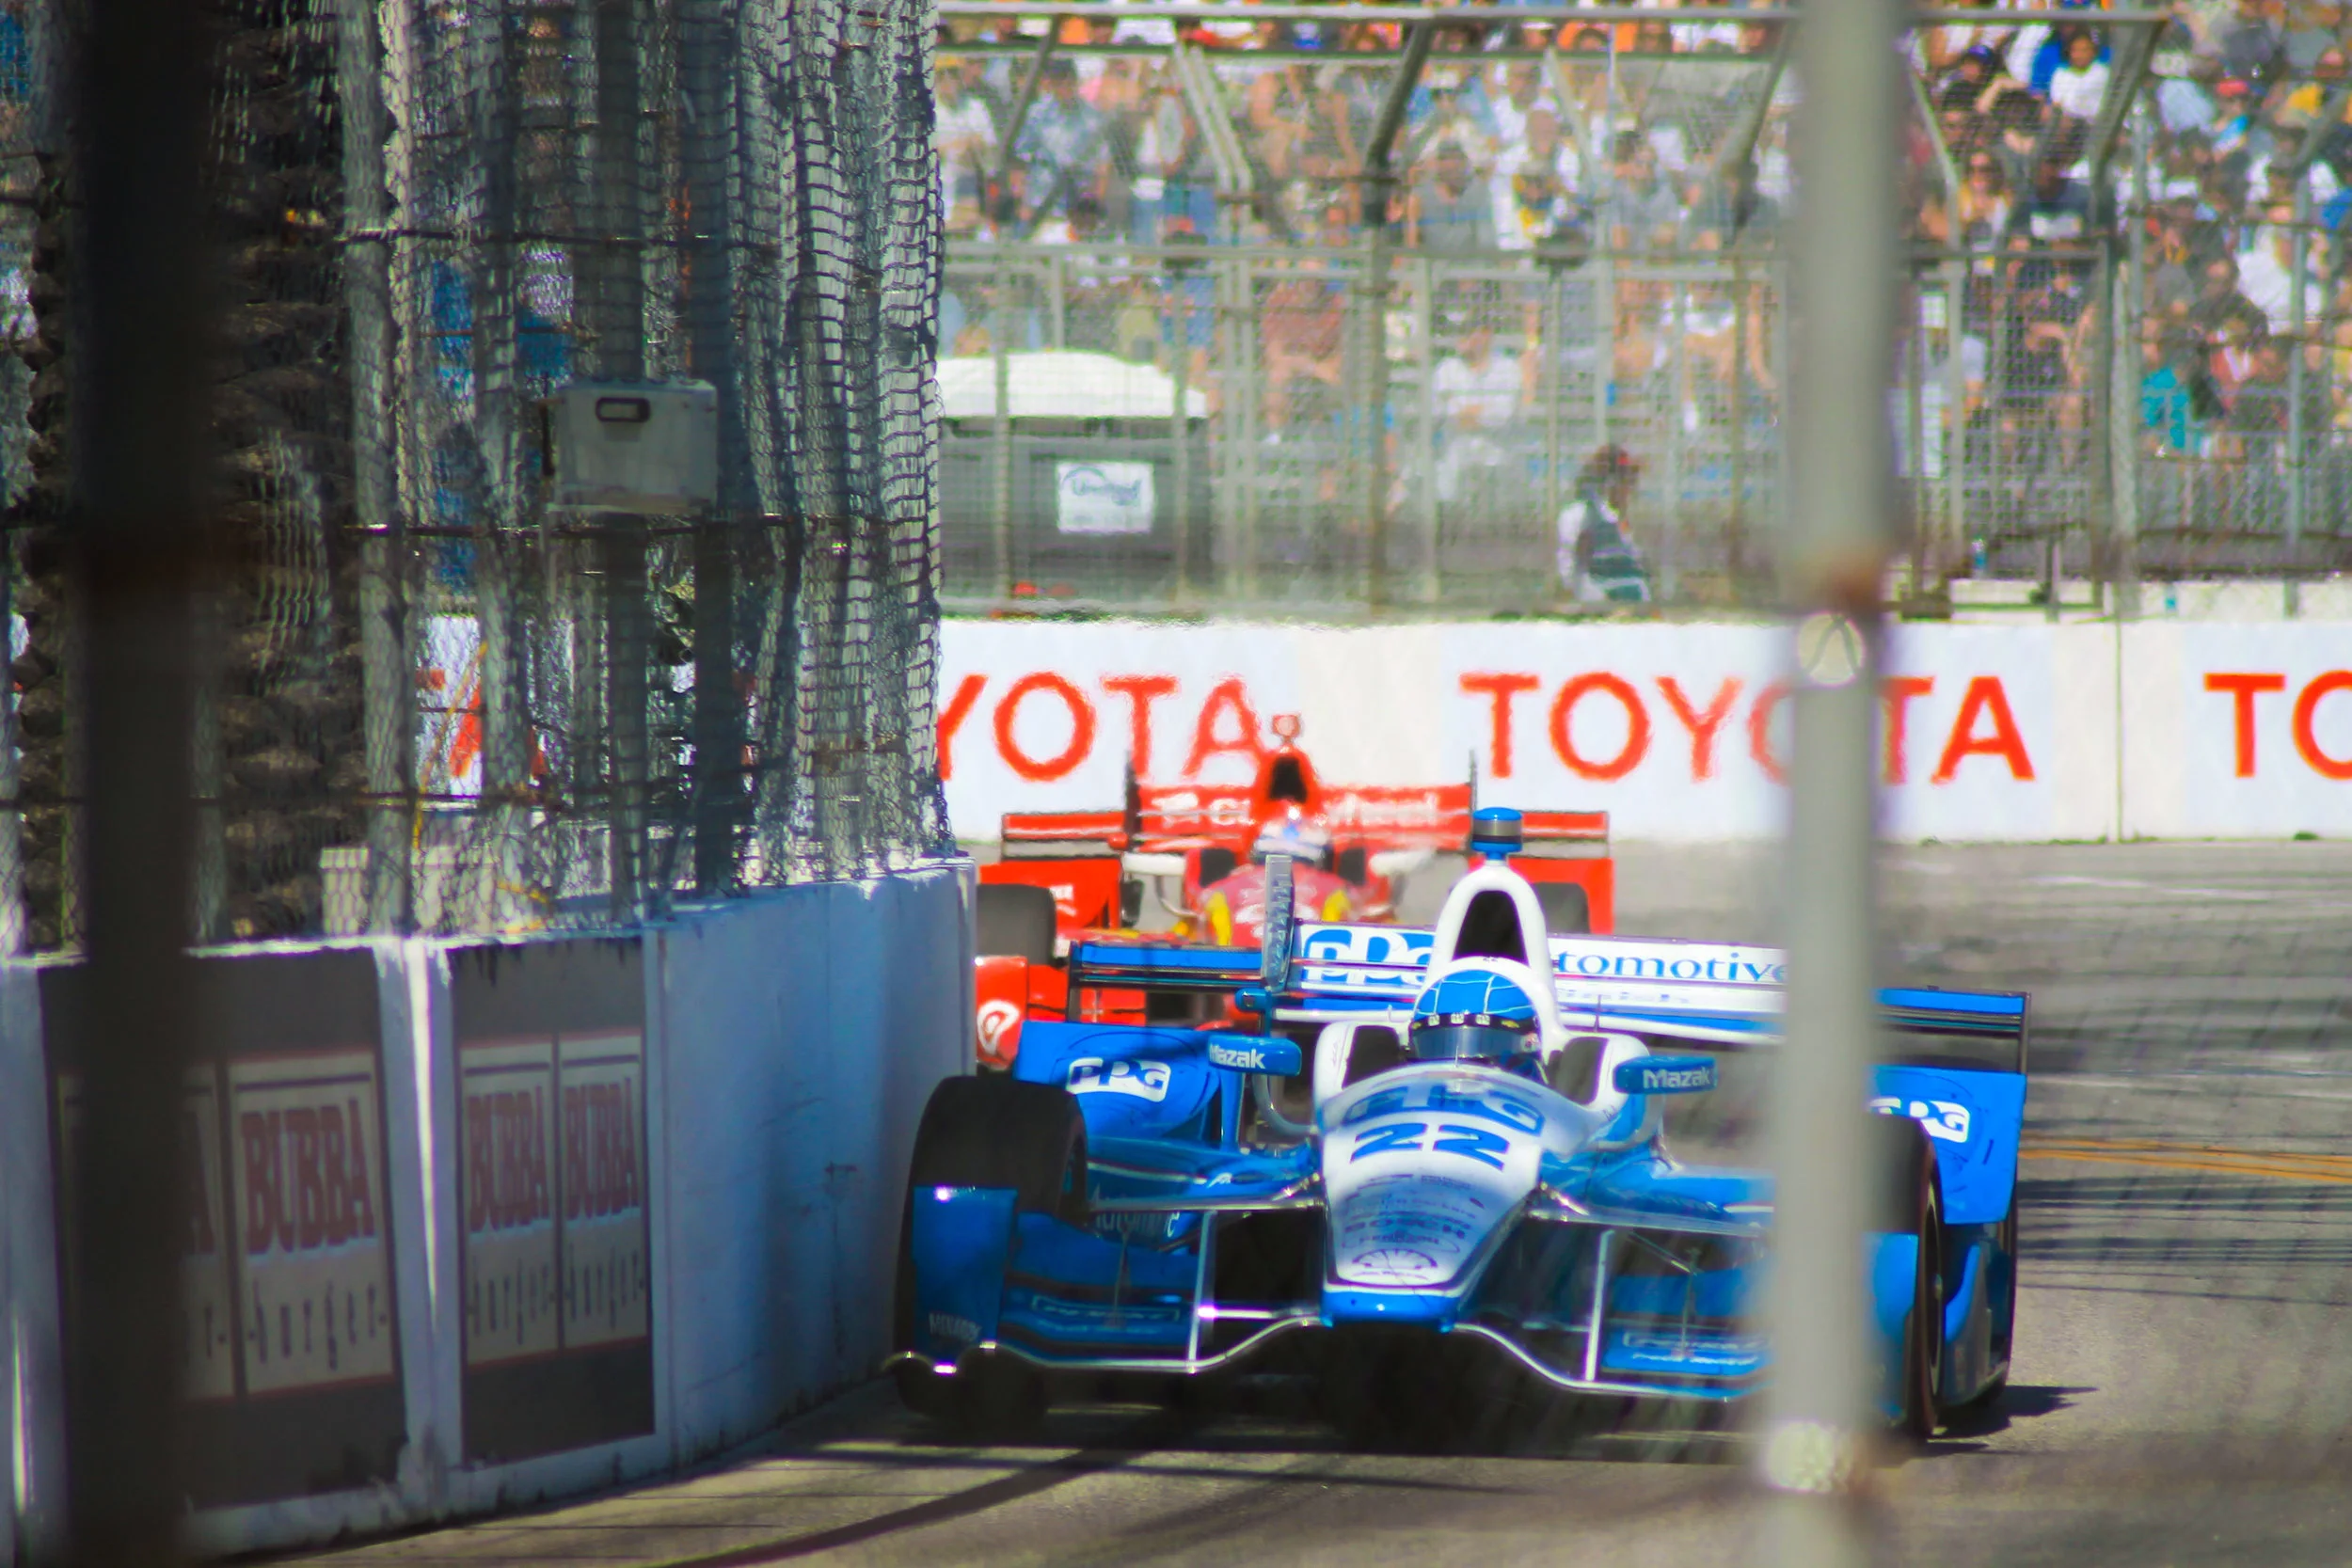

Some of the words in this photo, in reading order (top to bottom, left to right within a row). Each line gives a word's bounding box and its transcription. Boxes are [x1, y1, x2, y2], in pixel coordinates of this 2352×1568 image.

[1068, 1058, 1170, 1101] PPG
[1210, 1044, 1265, 1069] Mazak
[1642, 1066, 1711, 1089] Mazak
[468, 1085, 550, 1233] BUBBA
[565, 1076, 640, 1221] BUBBA
[1349, 1122, 1510, 1172] 22
[242, 1097, 375, 1255] BUBBA
